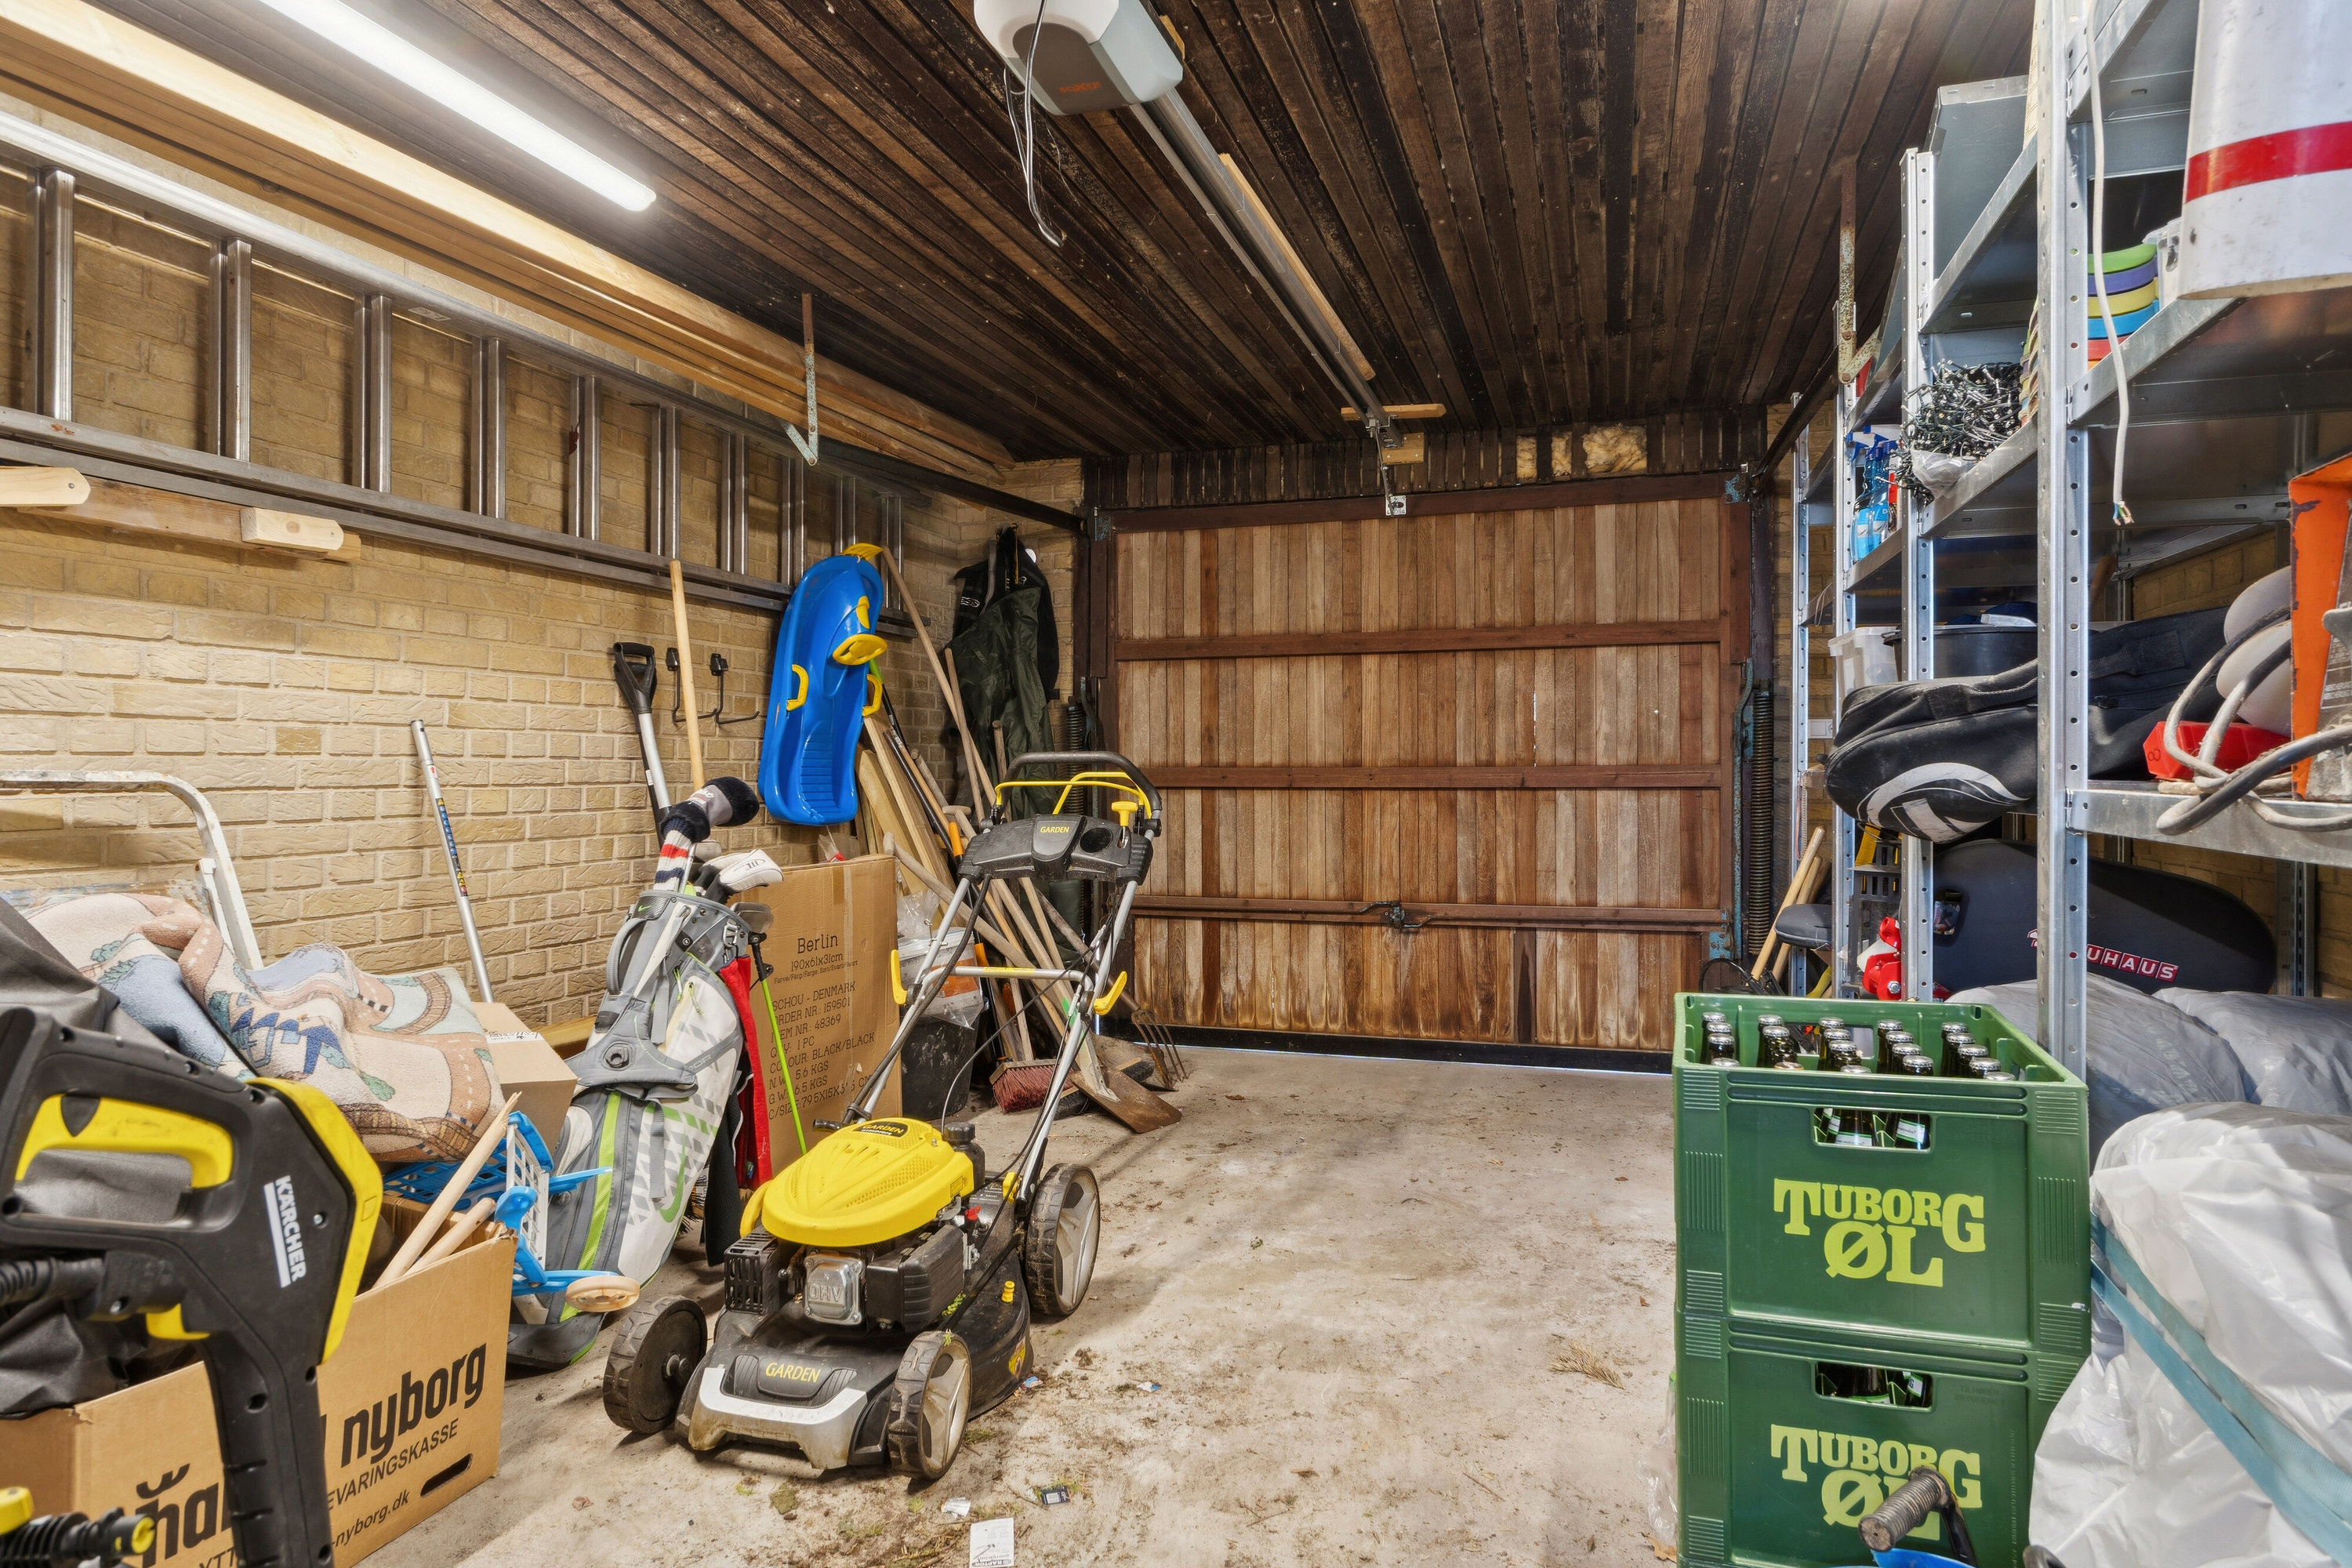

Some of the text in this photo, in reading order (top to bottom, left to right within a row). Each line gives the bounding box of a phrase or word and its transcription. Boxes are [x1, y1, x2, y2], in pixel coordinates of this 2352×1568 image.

[797, 934, 838, 954] Berlin
[791, 953, 844, 971] 190x61x31cm
[2087, 946, 2174, 979] UHAUS
[772, 993, 804, 1011] SCHOU
[813, 981, 856, 1001] DENMARK
[771, 1026, 793, 1043] IEM
[815, 1014, 841, 1029] 48369
[770, 1032, 875, 1073] COOUR: BLACK/BLACK
[771, 1043, 792, 1058] QY:
[803, 1036, 815, 1048] PC
[795, 1068, 808, 1080] 5.6
[811, 1061, 829, 1073] KGS
[795, 1082, 808, 1095] 6.5
[810, 1075, 828, 1090] KGS
[863, 1124, 904, 1134] GARDEN
[275, 1175, 307, 1283] KÄRCHER
[1773, 1178, 1986, 1253] TUBORG
[1824, 1221, 1943, 1287] ØL
[808, 1283, 843, 1303] OHV
[765, 1363, 821, 1383] GARDEN
[341, 1342, 487, 1468] nyborg
[327, 1417, 459, 1511] EVARINGSKASSE
[1771, 1424, 1983, 1508] TUBORG
[332, 1490, 412, 1548] -nyborg.dk
